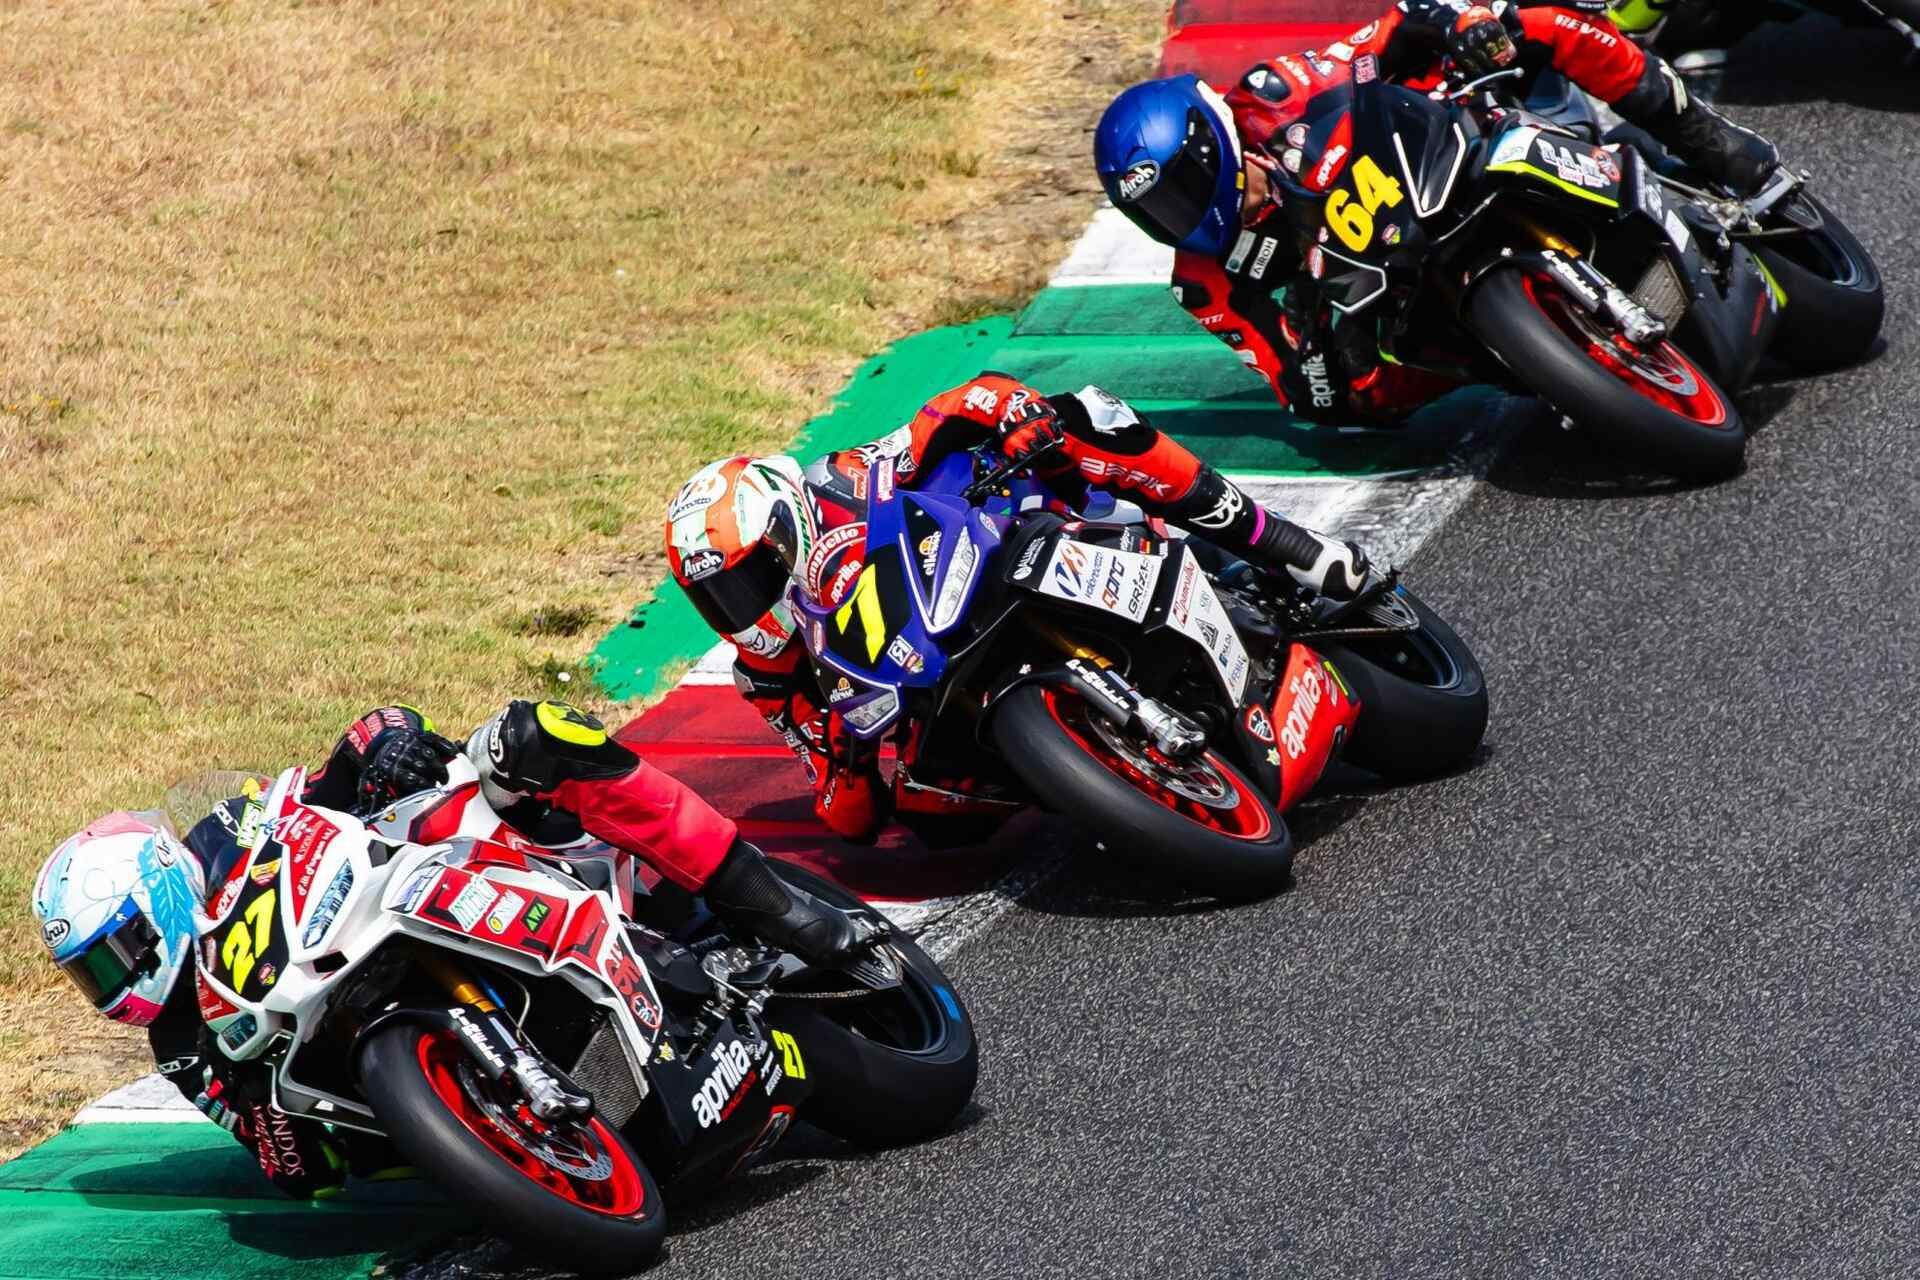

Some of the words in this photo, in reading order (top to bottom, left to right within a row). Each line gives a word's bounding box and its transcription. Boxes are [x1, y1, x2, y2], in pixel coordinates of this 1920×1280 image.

[1119, 167, 1155, 198] Airoh
[1325, 154, 1404, 252] 64
[1253, 239, 1275, 276] AIROH
[684, 550, 722, 577] Airoh
[831, 560, 862, 603] aprilia
[836, 563, 886, 664] 7
[1280, 668, 1322, 760] aprilia
[222, 888, 276, 995] 27
[691, 1039, 752, 1129] aprilia
[771, 1029, 807, 1080] 27
